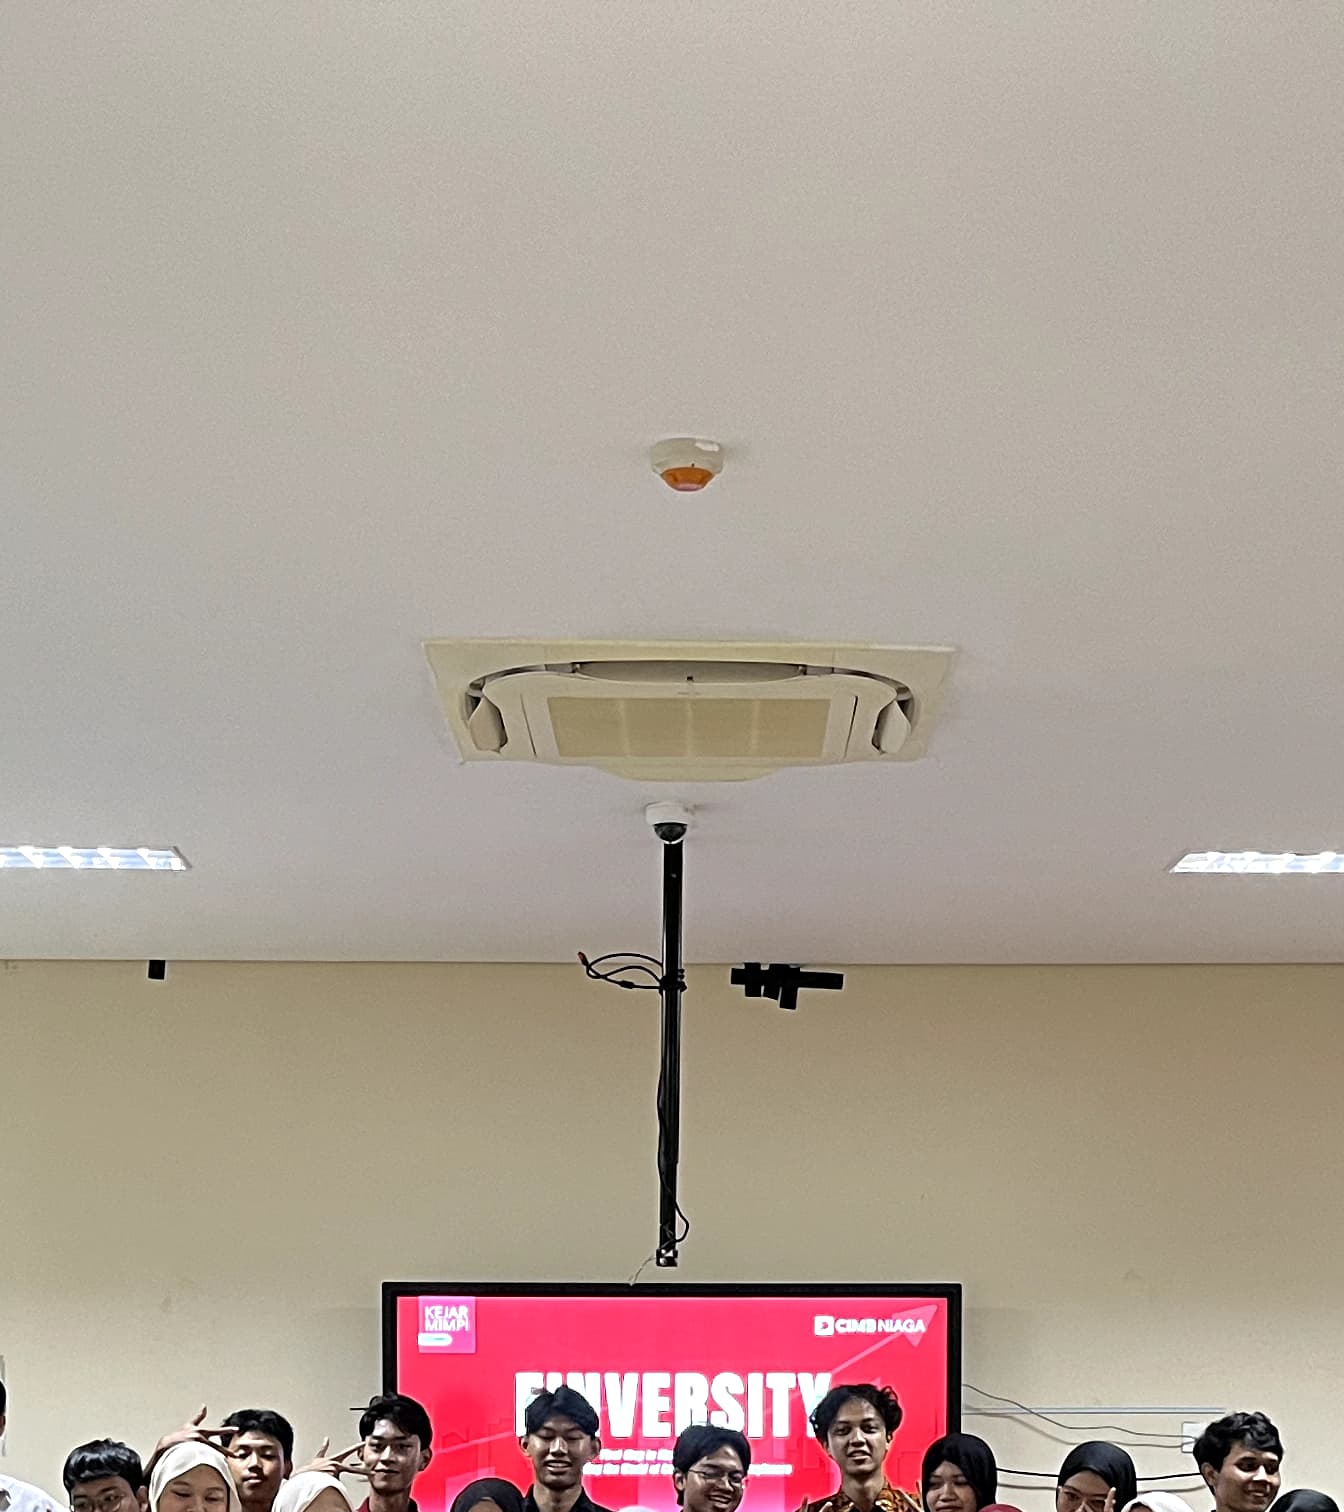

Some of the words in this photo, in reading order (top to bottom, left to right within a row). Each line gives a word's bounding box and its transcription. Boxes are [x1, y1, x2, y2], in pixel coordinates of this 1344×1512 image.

[424, 1305, 469, 1319] KEJAR
[424, 1318, 469, 1332] MIMPI
[877, 1318, 926, 1333] NIAGA
[515, 1371, 832, 1438] FNVERSITY
